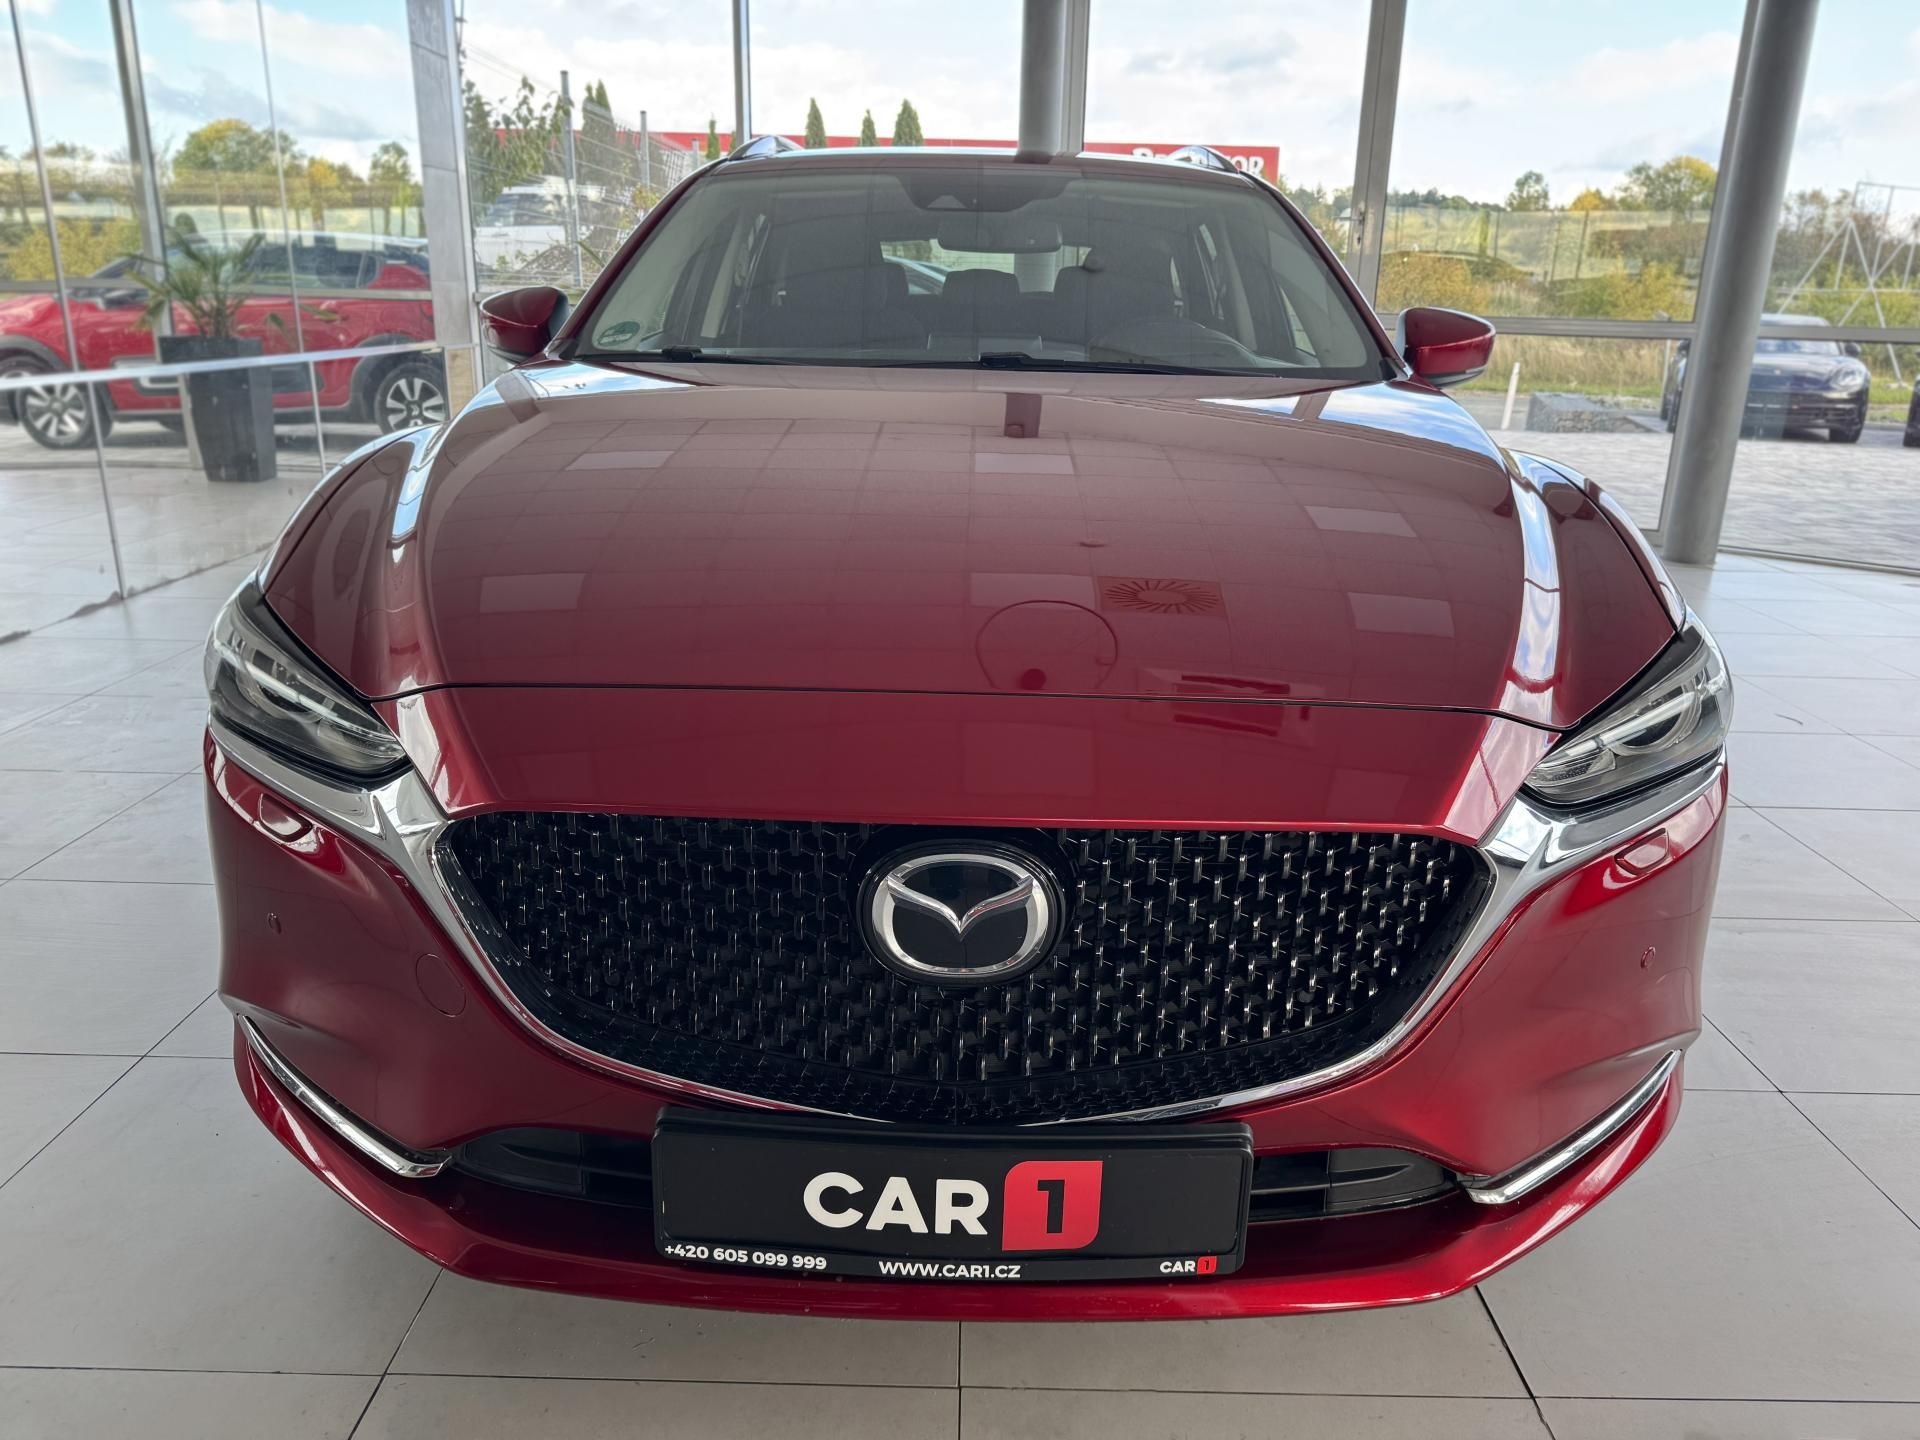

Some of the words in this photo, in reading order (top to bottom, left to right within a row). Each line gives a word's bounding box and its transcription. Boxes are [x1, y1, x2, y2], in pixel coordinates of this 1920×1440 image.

[664, 1243, 709, 1259] +420
[712, 1247, 749, 1263] 605
[751, 1251, 788, 1267] 099
[791, 1254, 827, 1270] 999
[878, 1260, 1021, 1279] WWW.CAR1.CZ
